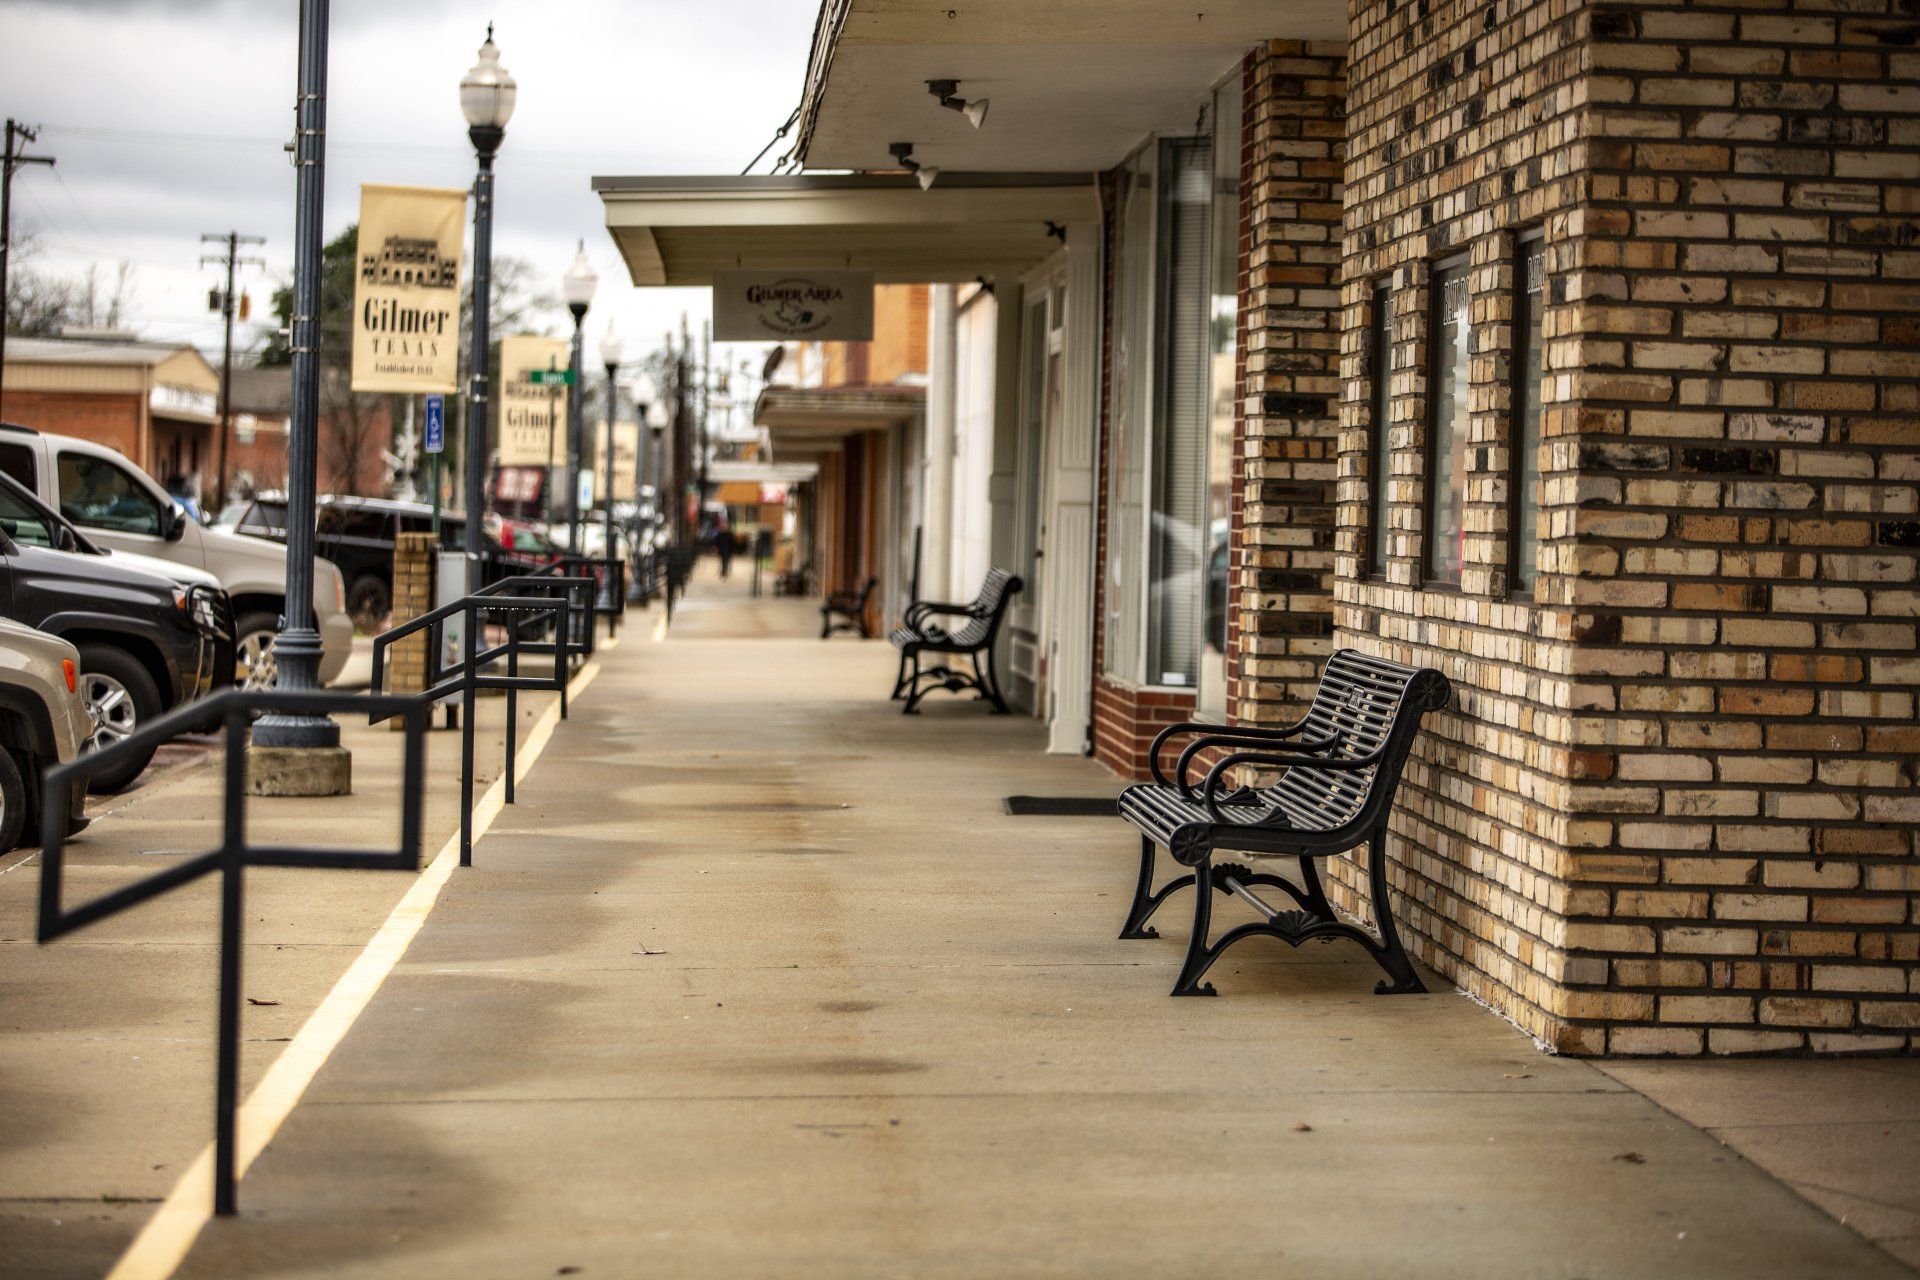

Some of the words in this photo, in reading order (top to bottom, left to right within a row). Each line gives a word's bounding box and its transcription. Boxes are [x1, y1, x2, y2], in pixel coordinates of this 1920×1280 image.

[747, 284, 803, 304] GILMER
[804, 286, 843, 305] AREA
[364, 297, 450, 335] Gilmer
[373, 339, 438, 358] TEXAS
